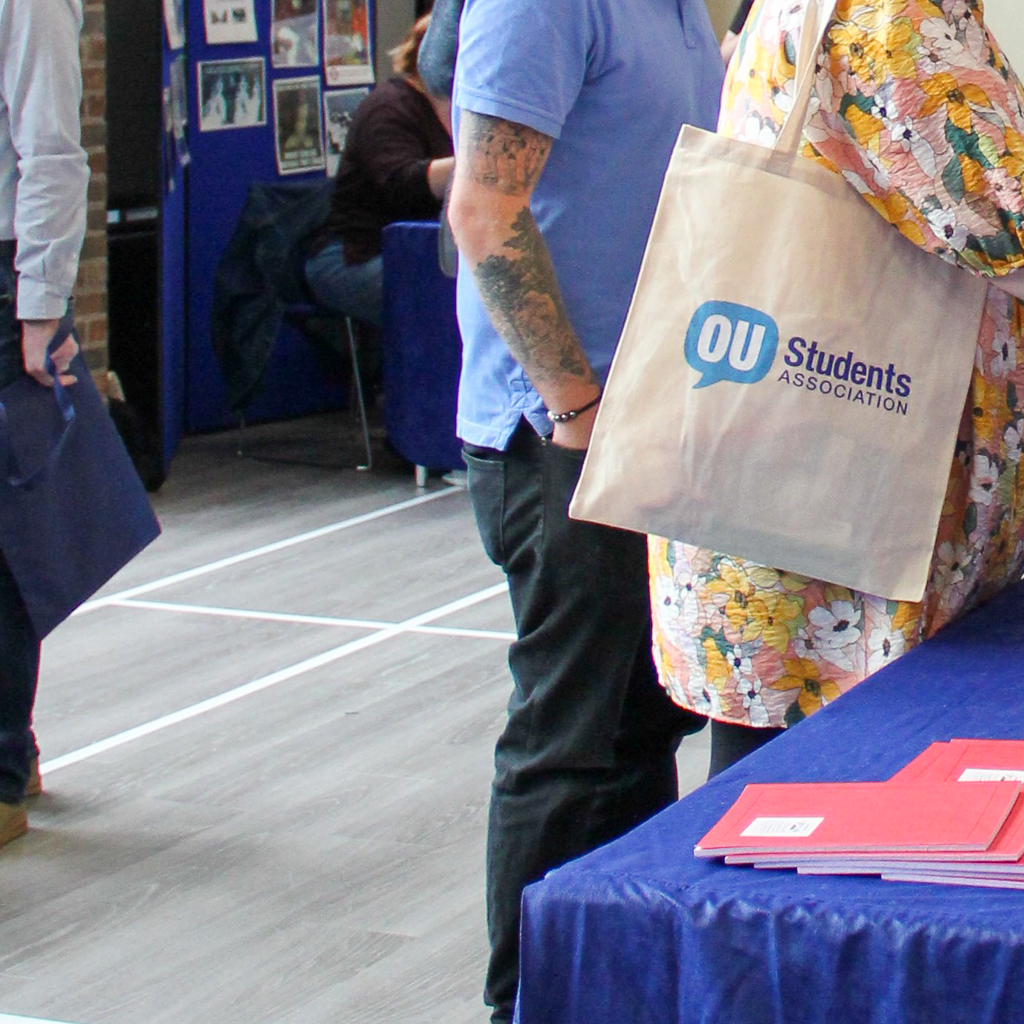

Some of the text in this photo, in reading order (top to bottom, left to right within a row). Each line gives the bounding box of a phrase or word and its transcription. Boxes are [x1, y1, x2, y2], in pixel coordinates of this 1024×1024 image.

[697, 314, 766, 371] OU
[784, 336, 912, 397] Students
[777, 370, 908, 415] ASSOCIATION
